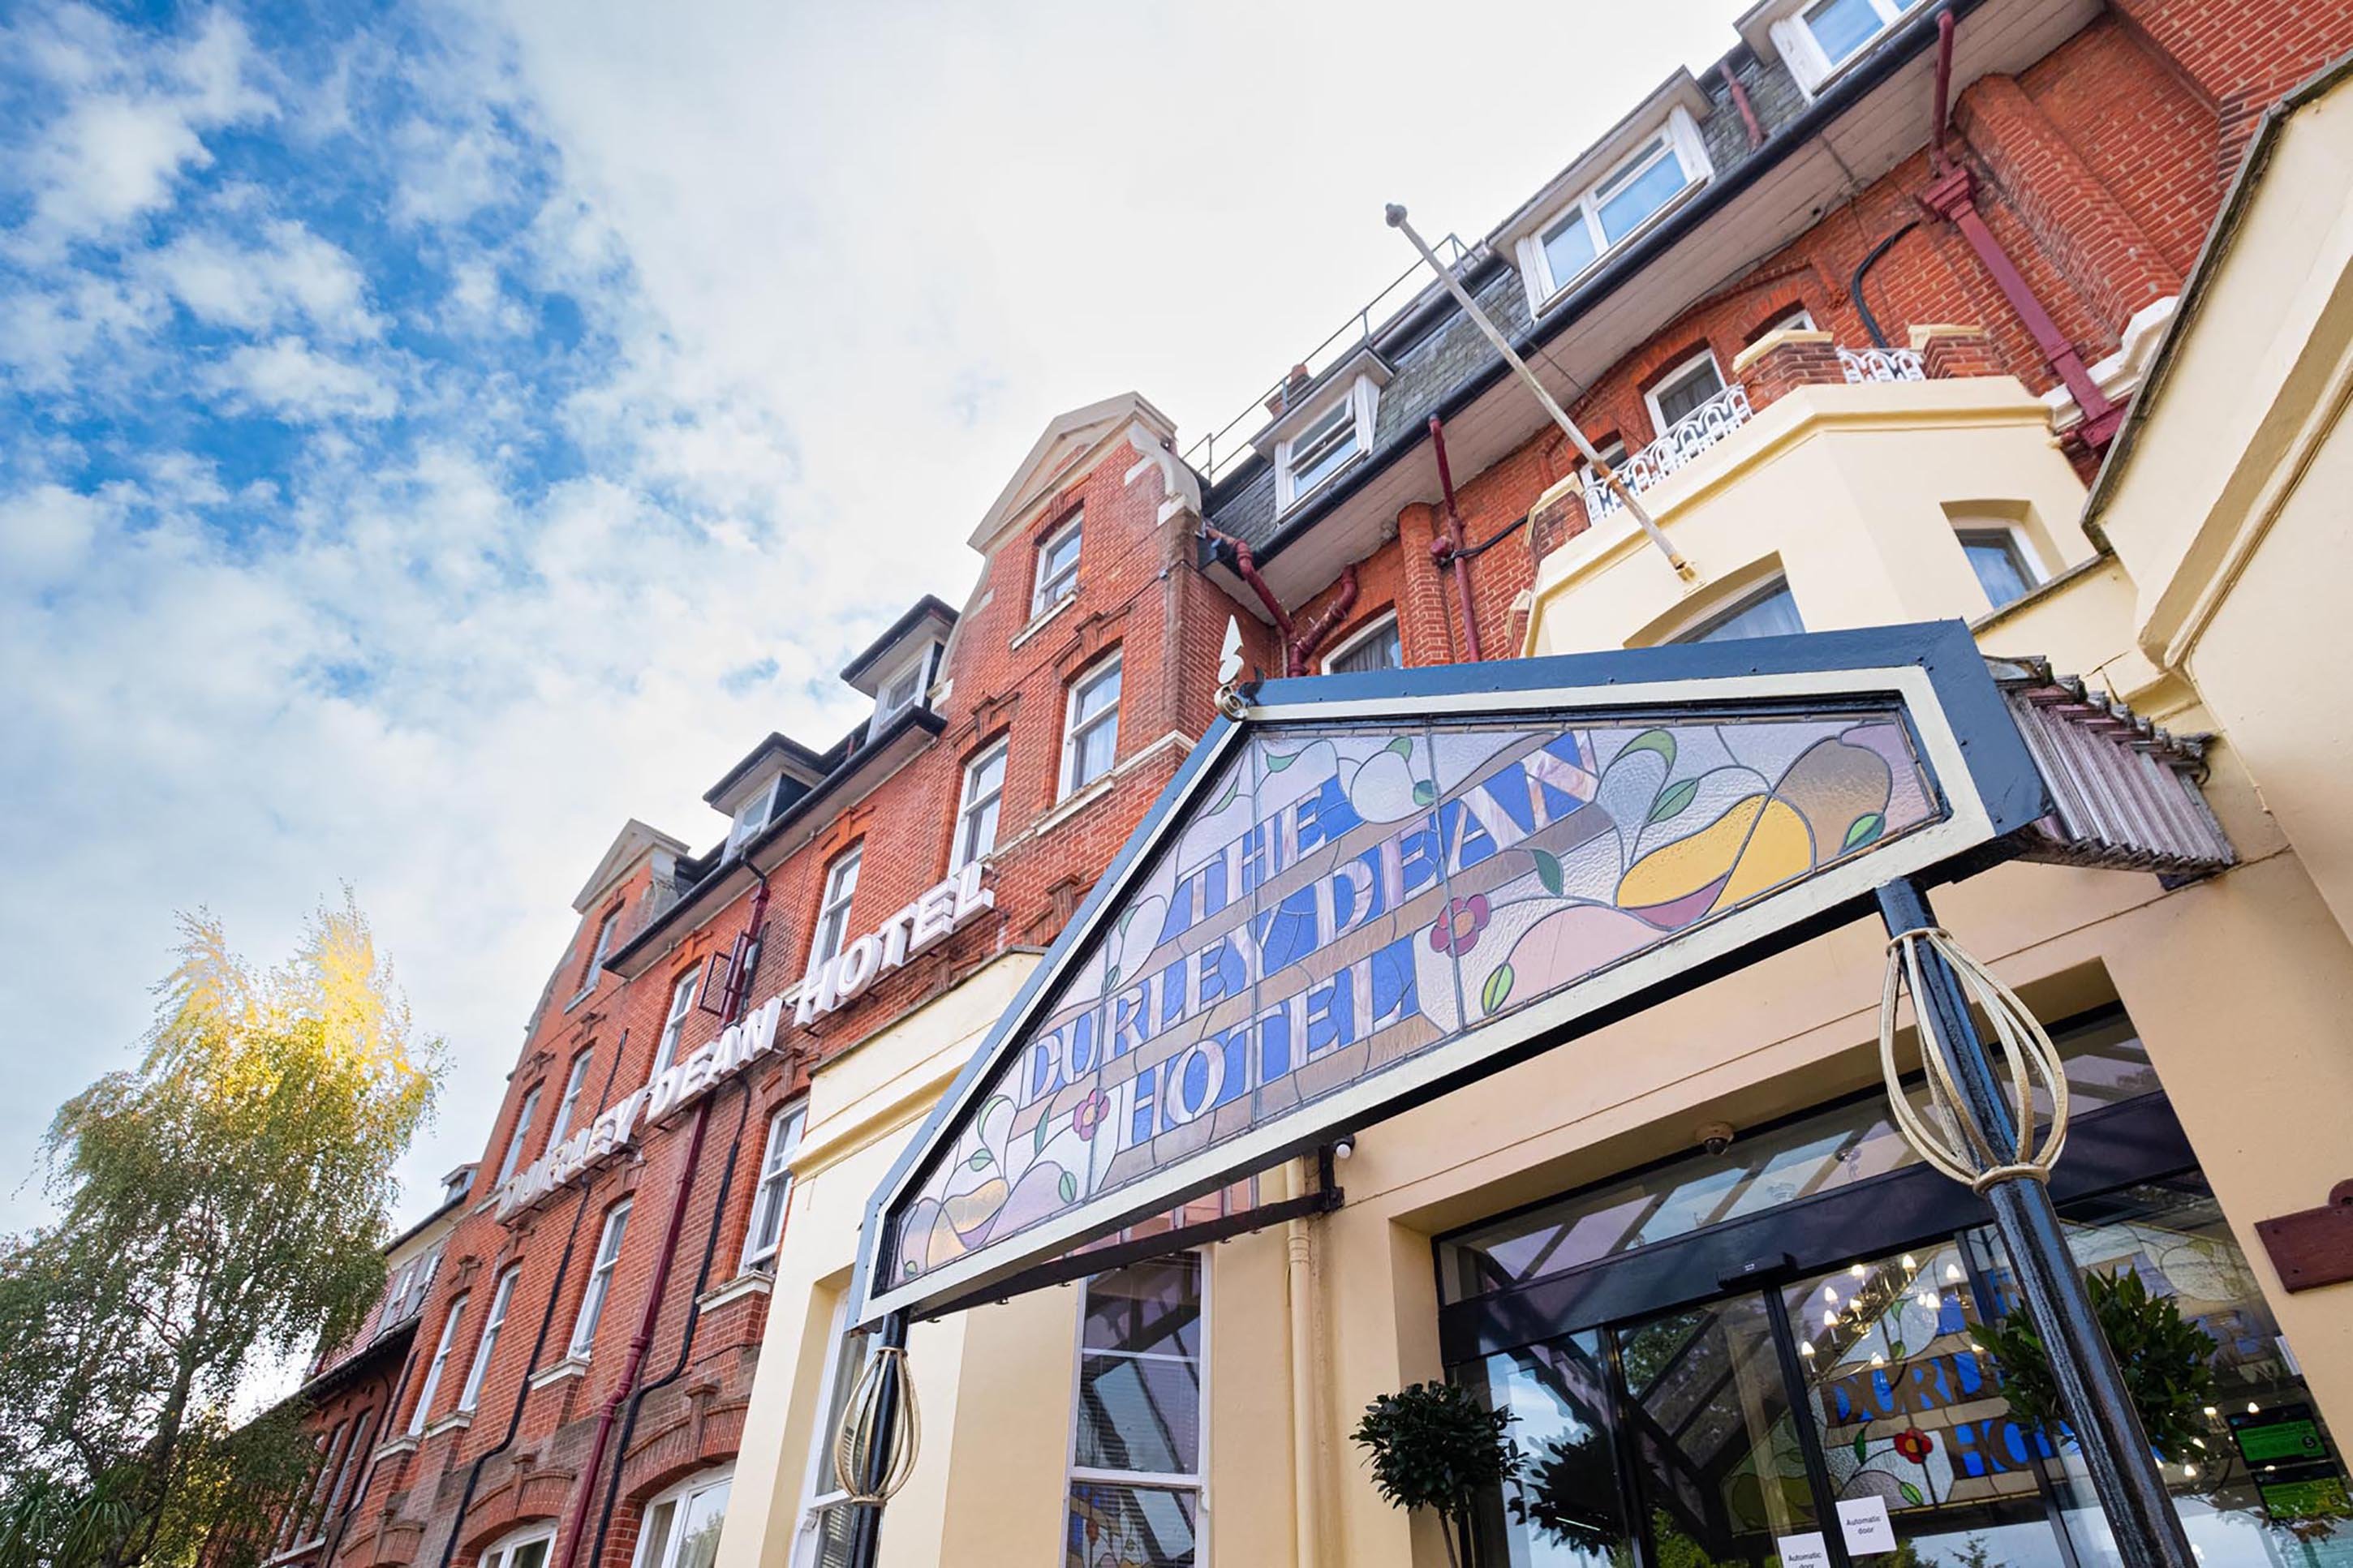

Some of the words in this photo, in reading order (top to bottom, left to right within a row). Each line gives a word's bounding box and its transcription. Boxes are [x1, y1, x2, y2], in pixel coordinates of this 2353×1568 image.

[1022, 900, 1284, 1110] DURLEY
[1314, 729, 1600, 950] DEAN
[1176, 784, 1327, 928] THE
[494, 1083, 652, 1225] DURLEY
[644, 996, 785, 1126] DEAN
[793, 860, 995, 1032] HOTEL
[1116, 955, 1403, 1152] HOTEL
[1788, 1552, 1822, 1562] Automatic
[1847, 1516, 1882, 1526] Automatic
